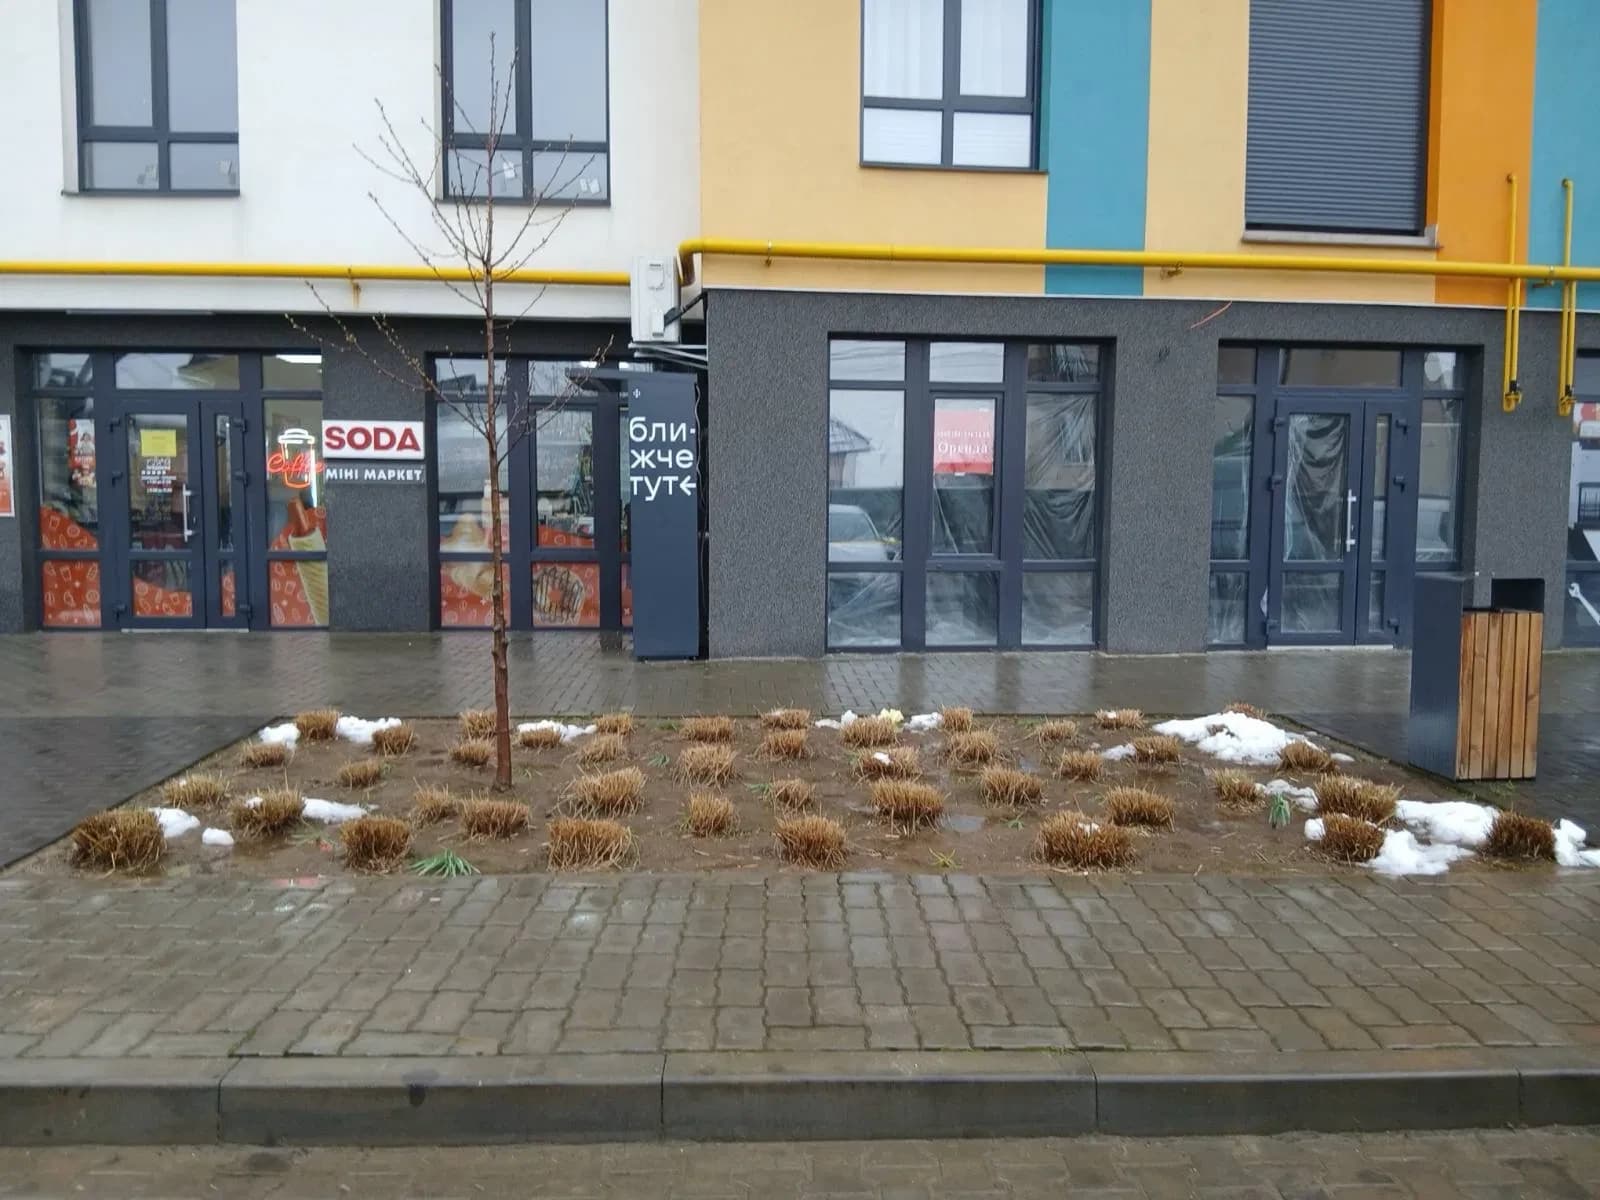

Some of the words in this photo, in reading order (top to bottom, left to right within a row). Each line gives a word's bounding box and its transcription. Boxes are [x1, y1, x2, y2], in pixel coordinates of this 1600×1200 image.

[324, 426, 421, 452] SODA
[630, 449, 694, 469] жче
[325, 468, 359, 480] МІНІ
[363, 469, 422, 481] МАРКЕТ
[629, 476, 679, 501] тут
